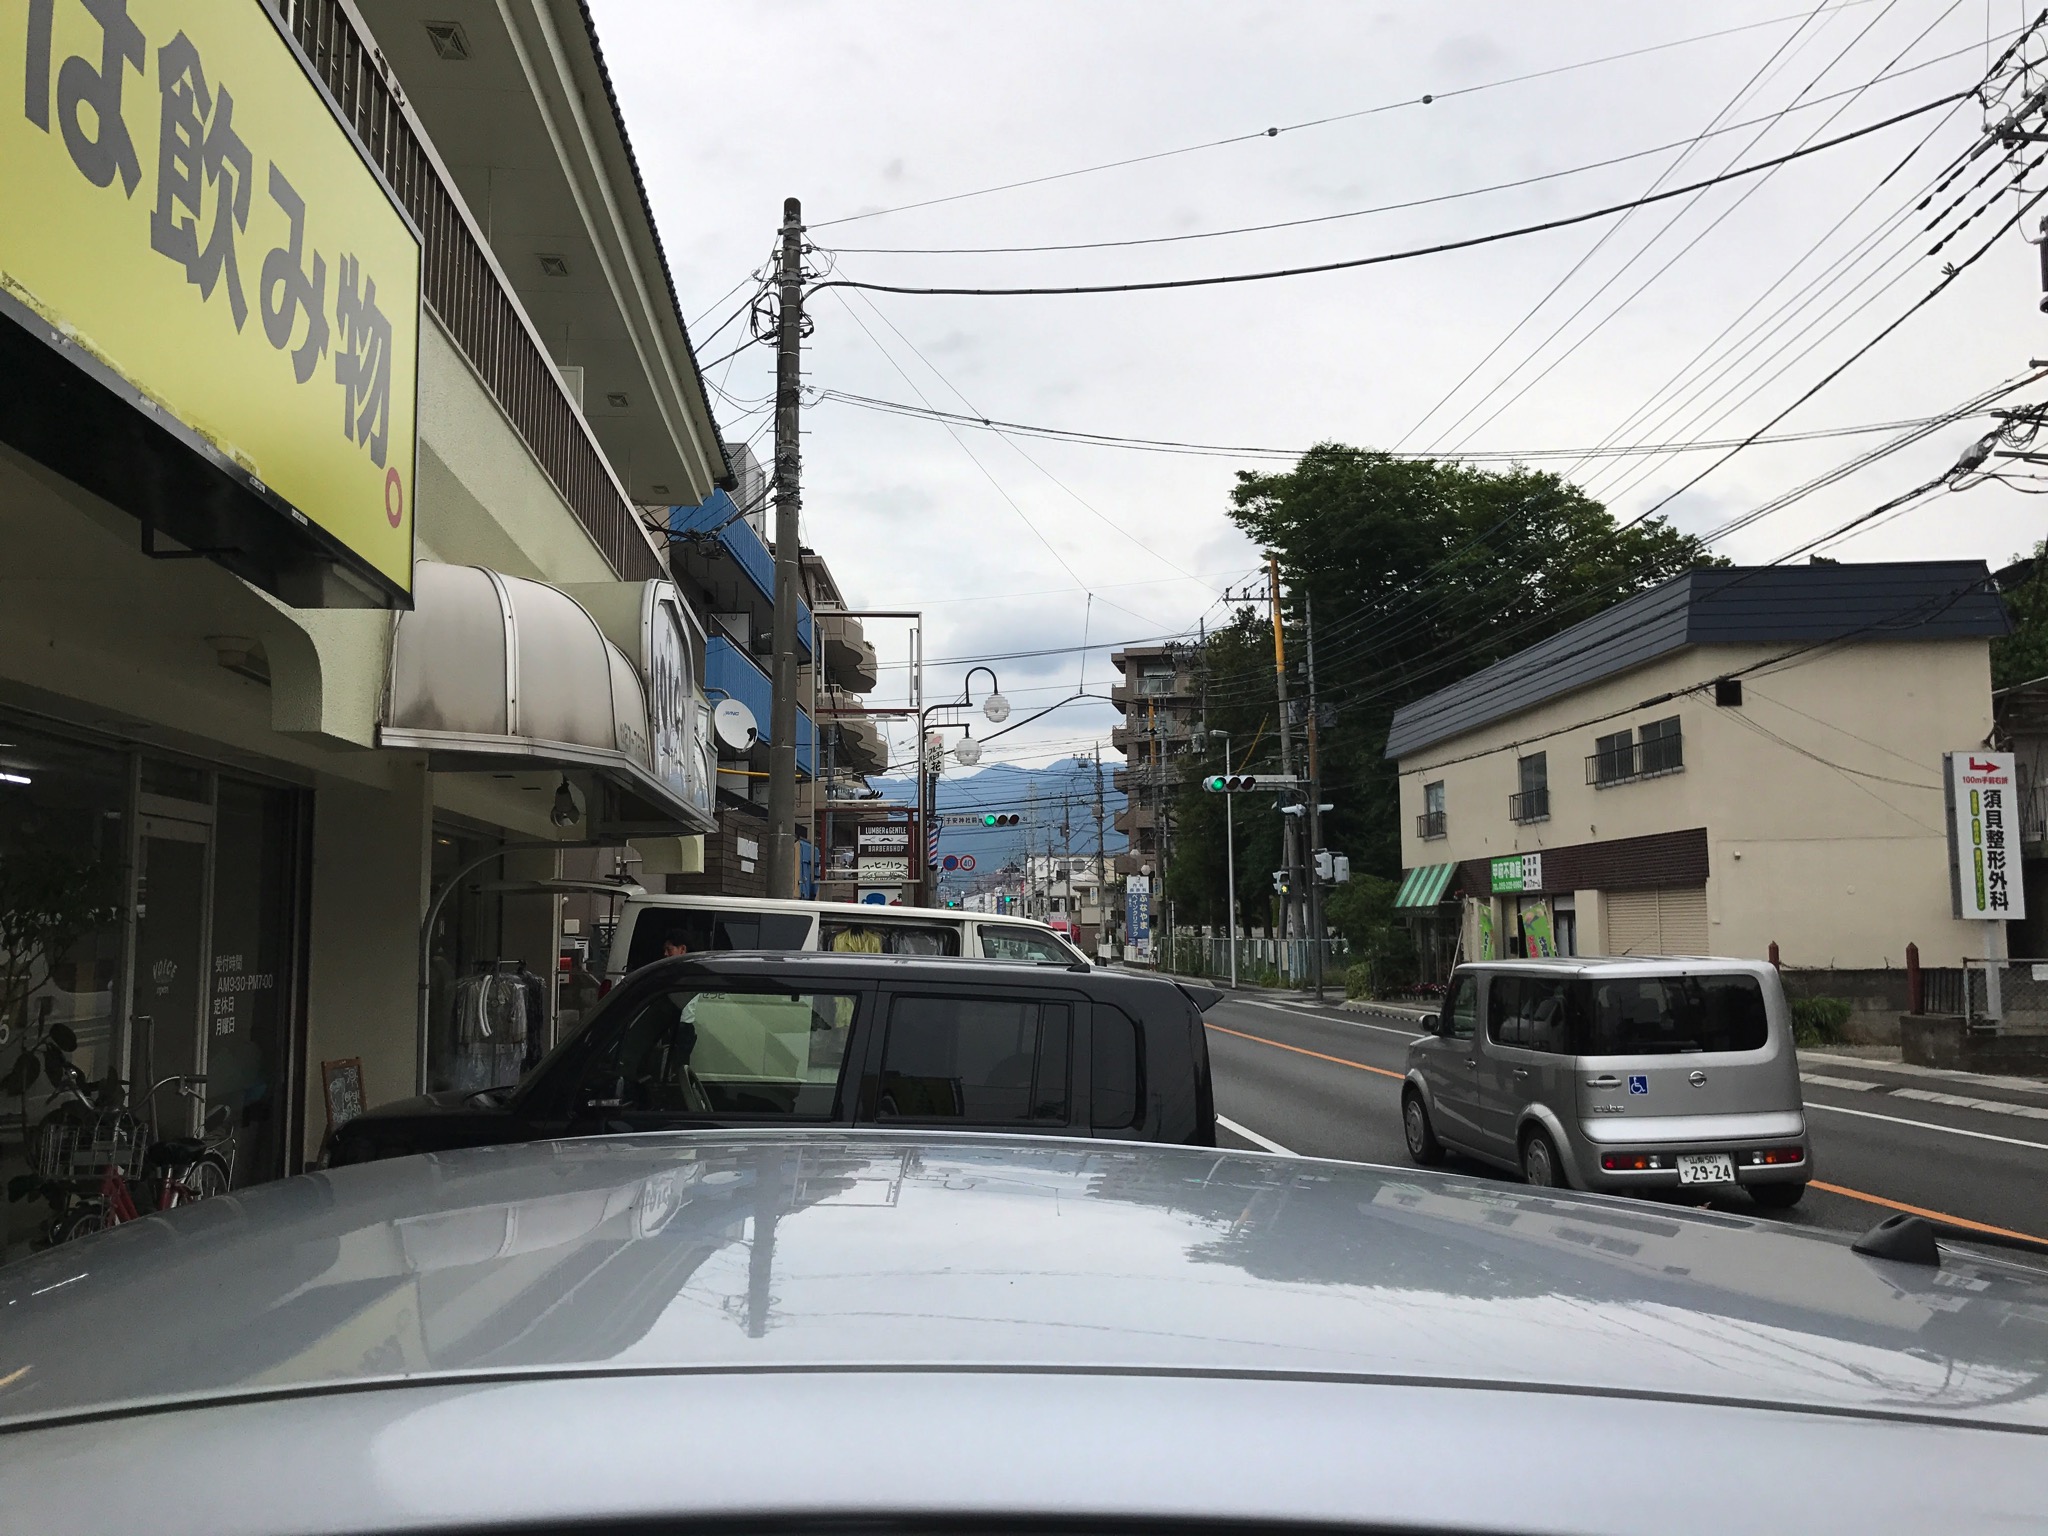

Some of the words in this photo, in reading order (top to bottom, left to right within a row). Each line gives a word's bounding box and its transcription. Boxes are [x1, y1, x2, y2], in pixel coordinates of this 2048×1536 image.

[930, 760, 942, 772] 花
[868, 845, 905, 853] BARBERSHOP
[1983, 789, 2009, 911] 須貝整形外科
[963, 858, 973, 867] 40
[1139, 894, 1148, 930] ふなやま
[215, 954, 243, 973] 受付時間
[213, 996, 235, 1015] 定休日
[215, 1016, 235, 1036] 月曜日
[1690, 1164, 1731, 1181] 29-24
